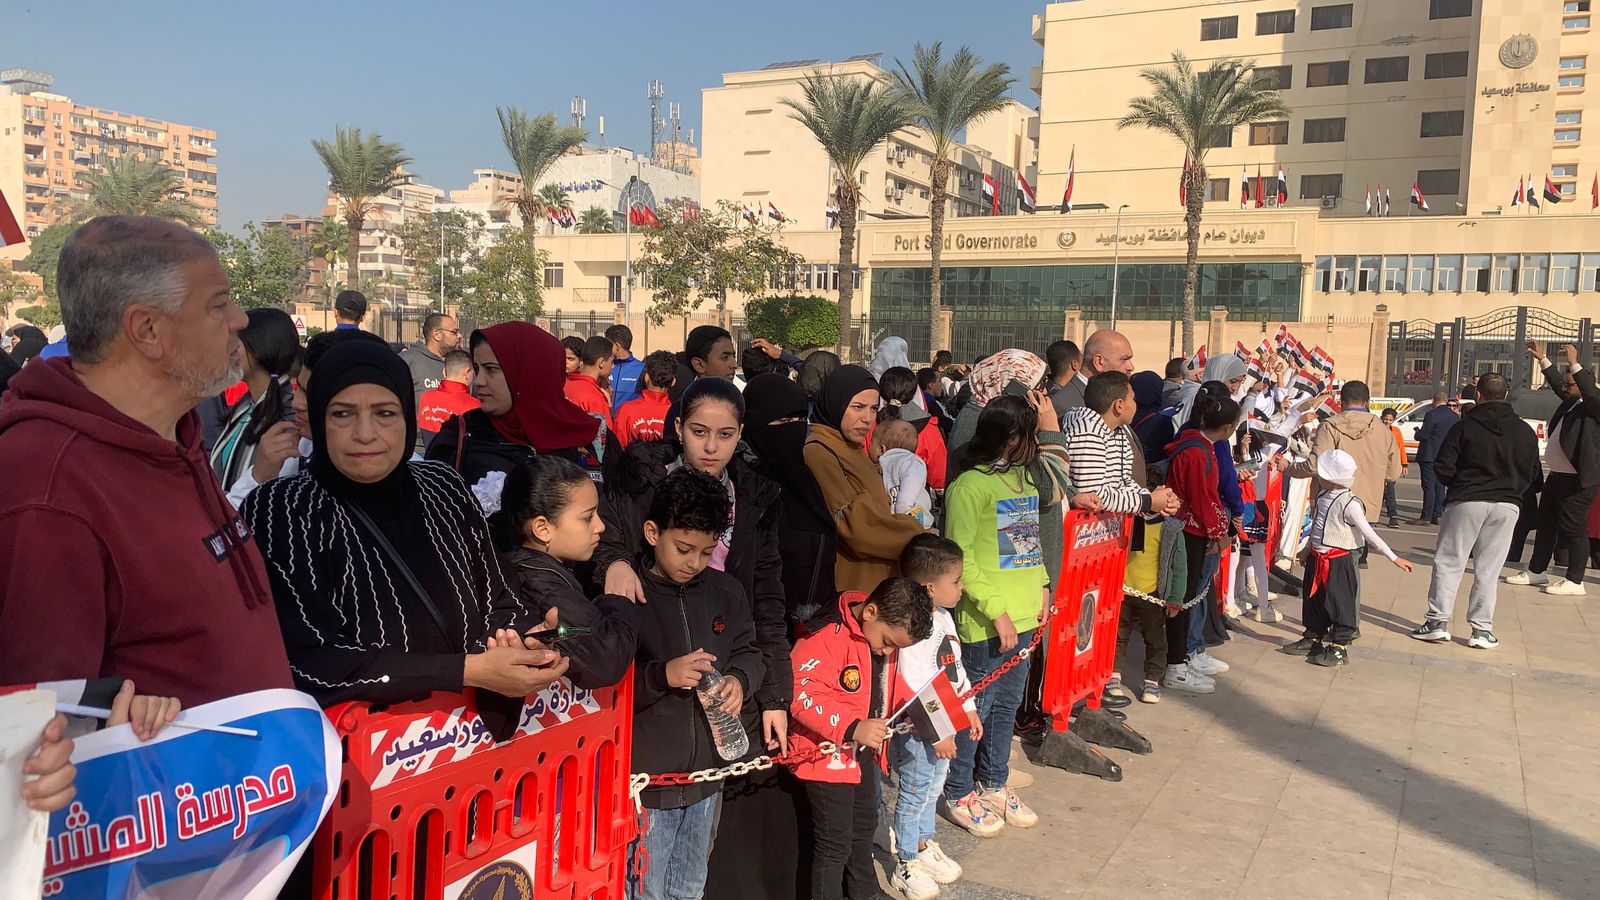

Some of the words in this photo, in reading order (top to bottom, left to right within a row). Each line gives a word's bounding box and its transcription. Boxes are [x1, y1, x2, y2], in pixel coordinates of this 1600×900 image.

[894, 235, 920, 251] Port
[956, 233, 1038, 250] Governorate
[1203, 229, 1227, 245] عام
[1229, 226, 1266, 245] ديوان
[177, 764, 296, 841] مدرسة
